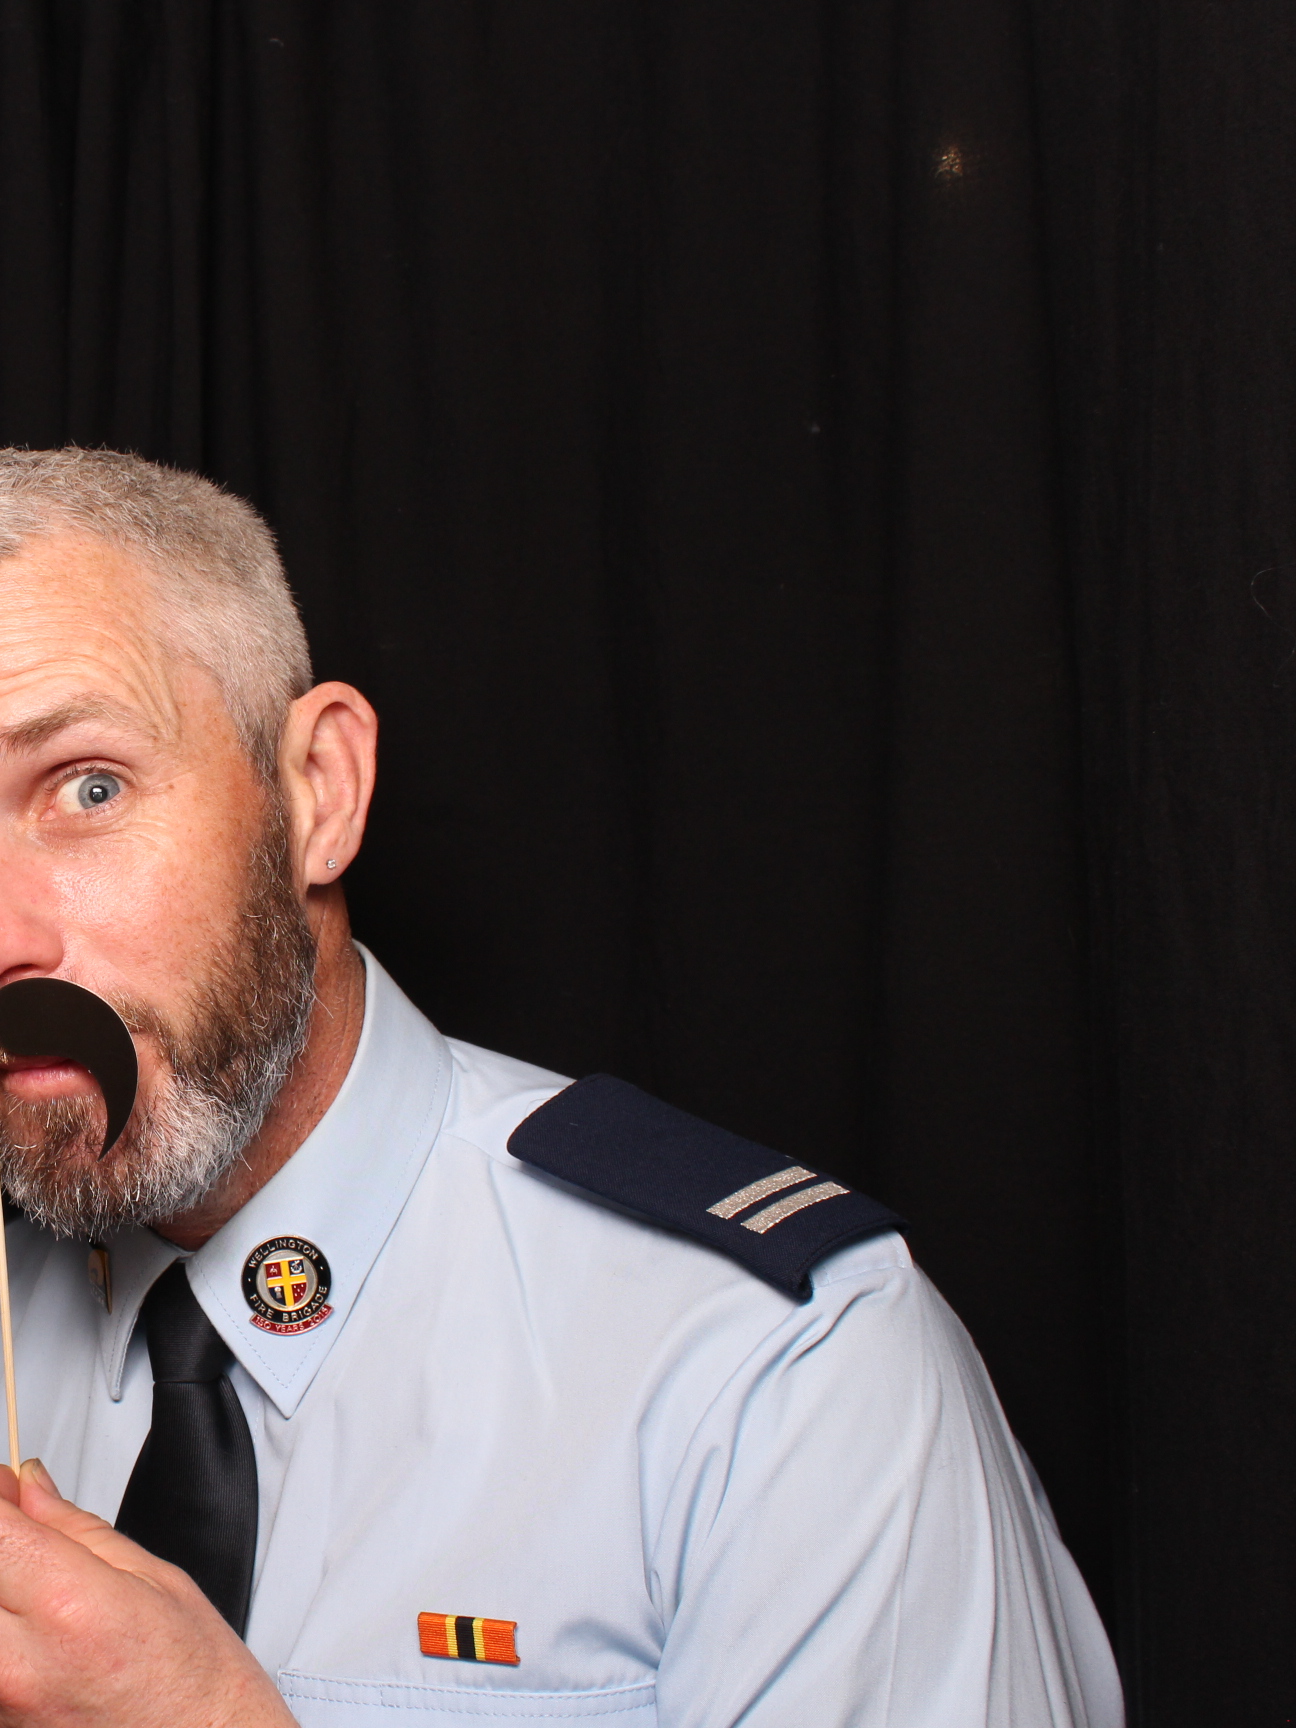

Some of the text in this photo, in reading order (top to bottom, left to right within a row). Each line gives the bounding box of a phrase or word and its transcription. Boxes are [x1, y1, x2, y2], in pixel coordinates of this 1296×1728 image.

[248, 1239, 319, 1268] WELLINGTON
[249, 1286, 328, 1322] FIRE BRIGADE
[254, 1316, 271, 1329] 150
[275, 1322, 305, 1333] YEARS
